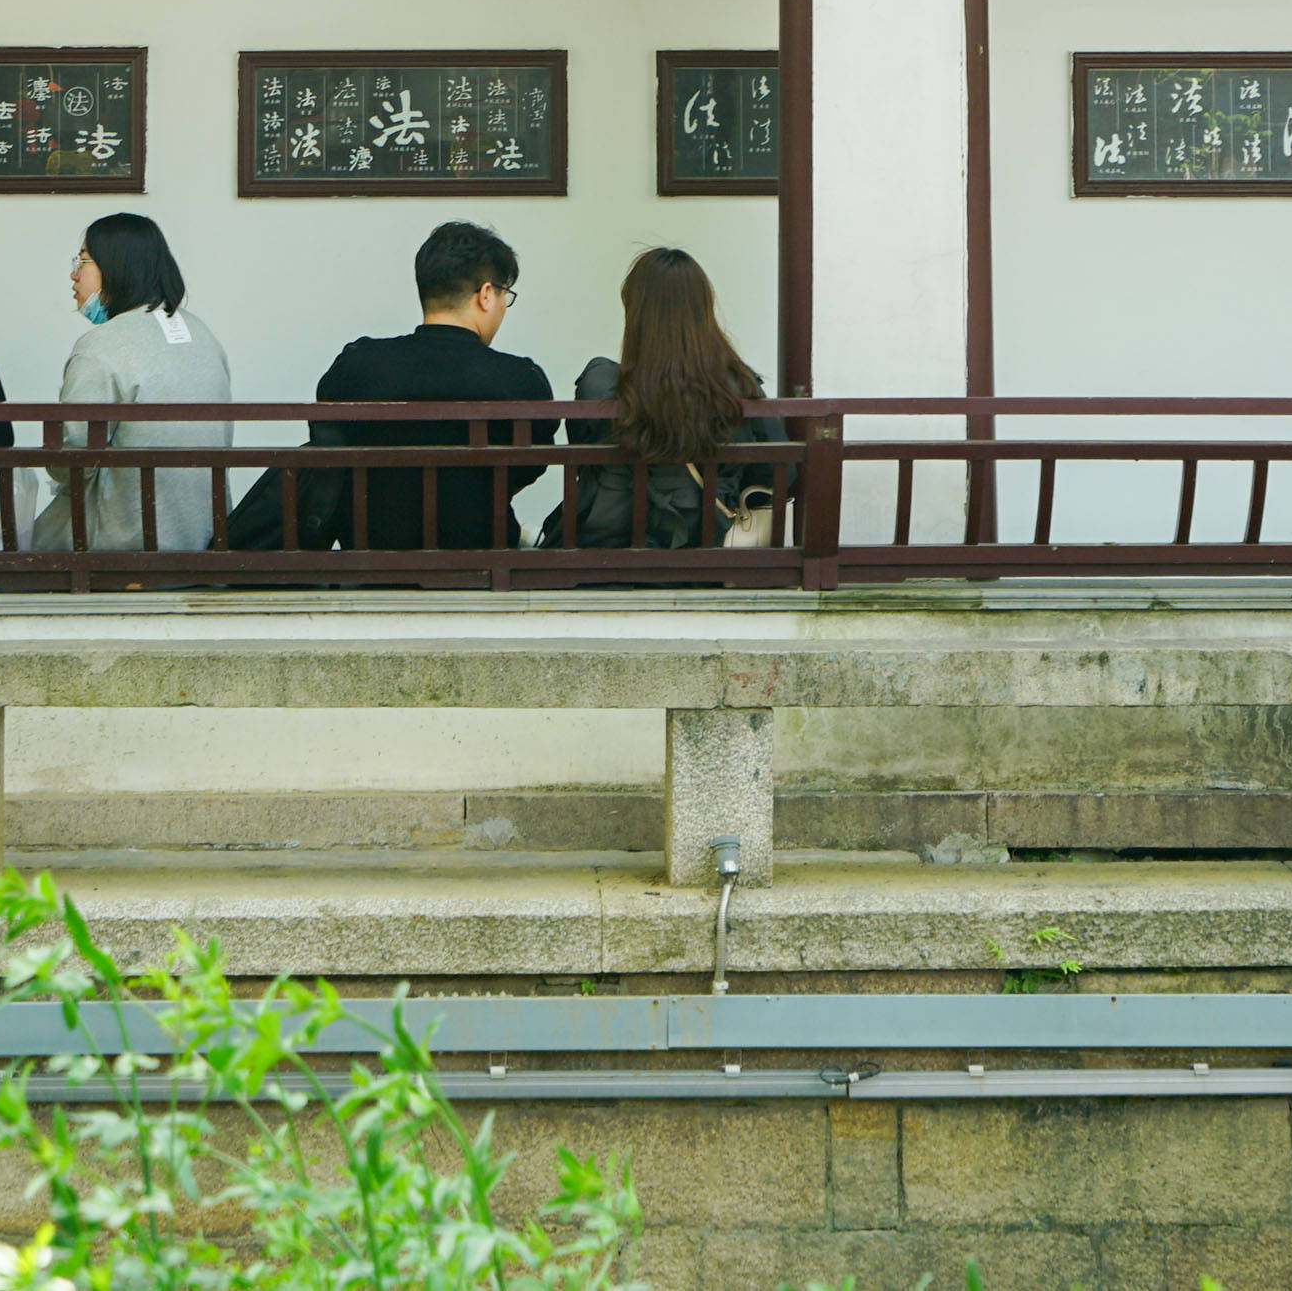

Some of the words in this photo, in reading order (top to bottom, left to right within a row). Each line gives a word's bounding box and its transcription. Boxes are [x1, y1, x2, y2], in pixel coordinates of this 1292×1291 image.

[263, 76, 284, 98] 法
[295, 87, 318, 108] 法
[487, 78, 506, 97] 法
[67, 91, 89, 113] 法
[369, 89, 430, 147] 法
[450, 115, 470, 134] 法
[487, 108, 507, 125] 法
[74, 123, 123, 160] 法
[290, 122, 321, 158] 法
[449, 148, 469, 165] 法
[485, 138, 524, 171] 法
